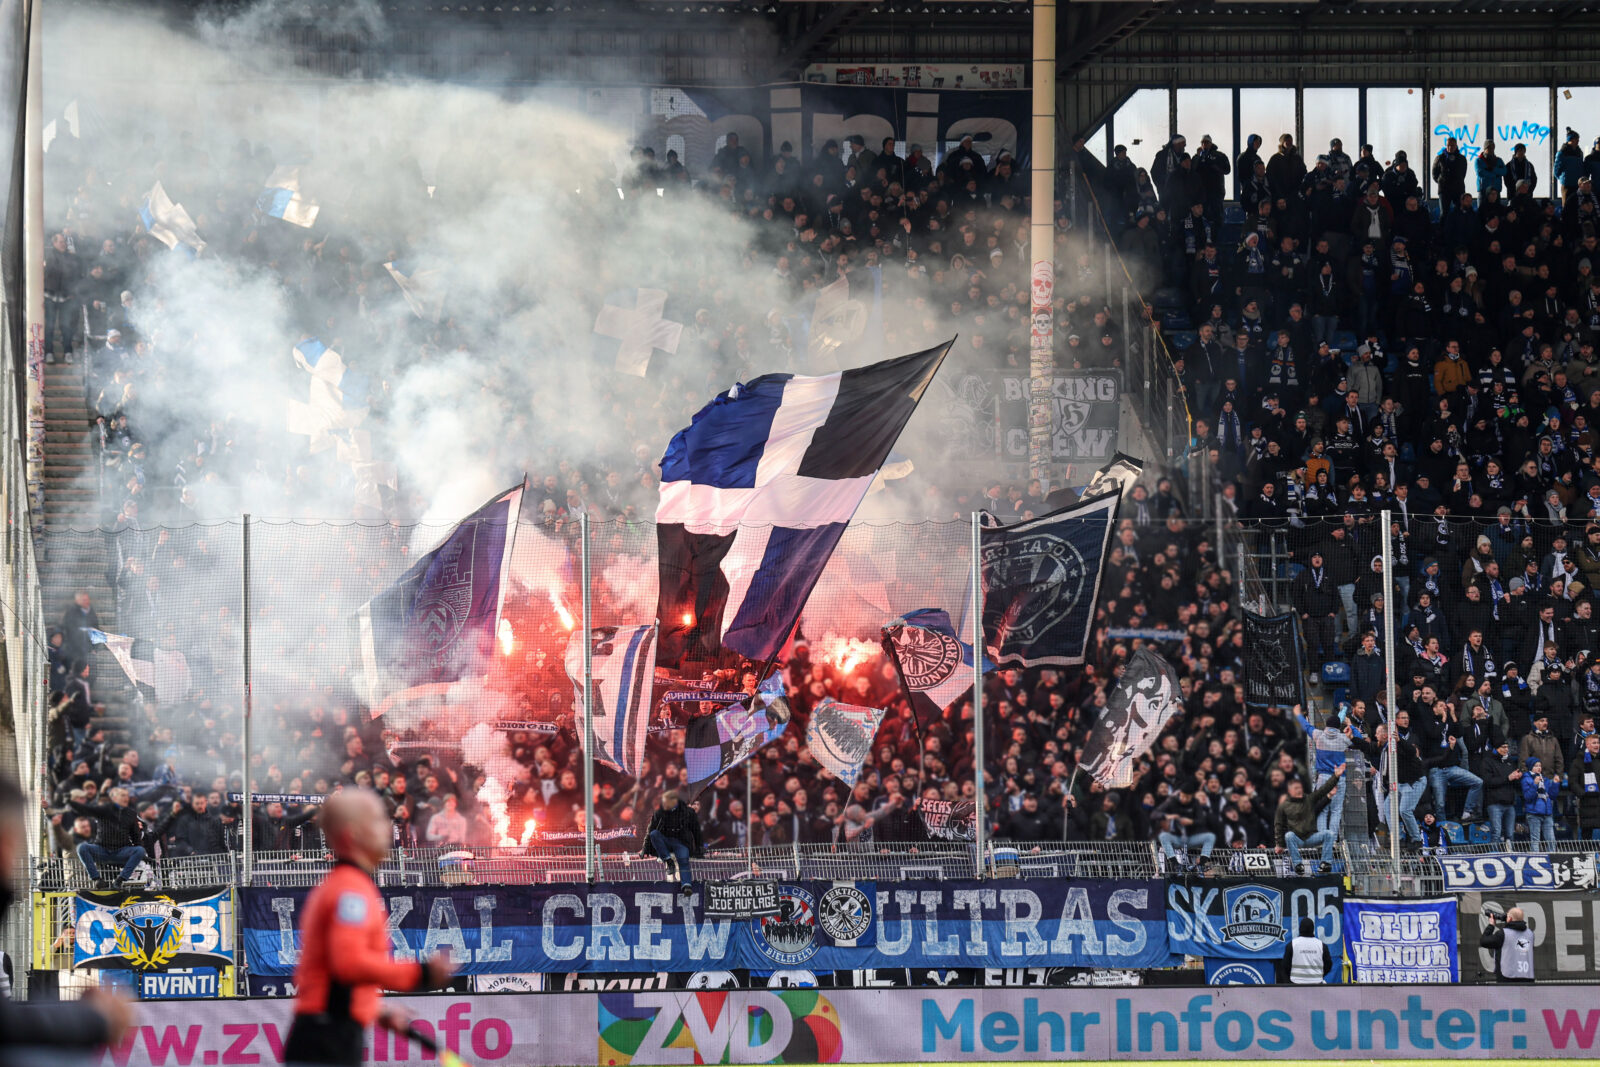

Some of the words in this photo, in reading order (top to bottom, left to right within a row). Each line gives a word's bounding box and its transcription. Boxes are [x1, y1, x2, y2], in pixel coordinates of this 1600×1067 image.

[1007, 428, 1112, 457] CEW
[232, 793, 325, 803] OTWESTFALEN
[920, 799, 953, 814] SECHS
[1246, 855, 1267, 868] 26
[1442, 856, 1554, 889] BOYS
[709, 898, 733, 910] JEDE
[735, 895, 777, 910] AUFLAGE
[710, 884, 753, 898] STÄRKER
[755, 883, 774, 897] ALS
[826, 887, 865, 902] SEKTION
[820, 912, 871, 940] STADIONVERBOT
[876, 887, 1149, 957] ULTRAS
[1168, 883, 1222, 945] SK
[1291, 886, 1341, 945] 05
[271, 896, 513, 965] LKAL
[542, 893, 732, 961] CREW
[1361, 913, 1438, 941] BLUE
[766, 947, 813, 963] BIELEFELD
[1355, 944, 1449, 967] HONOUR
[1517, 960, 1529, 973] 30
[144, 975, 215, 995] AVANTI
[632, 991, 794, 1065] ZVD
[921, 996, 1099, 1053] Mehr
[1116, 994, 1295, 1052] Infos
[1310, 994, 1528, 1051] unter:
